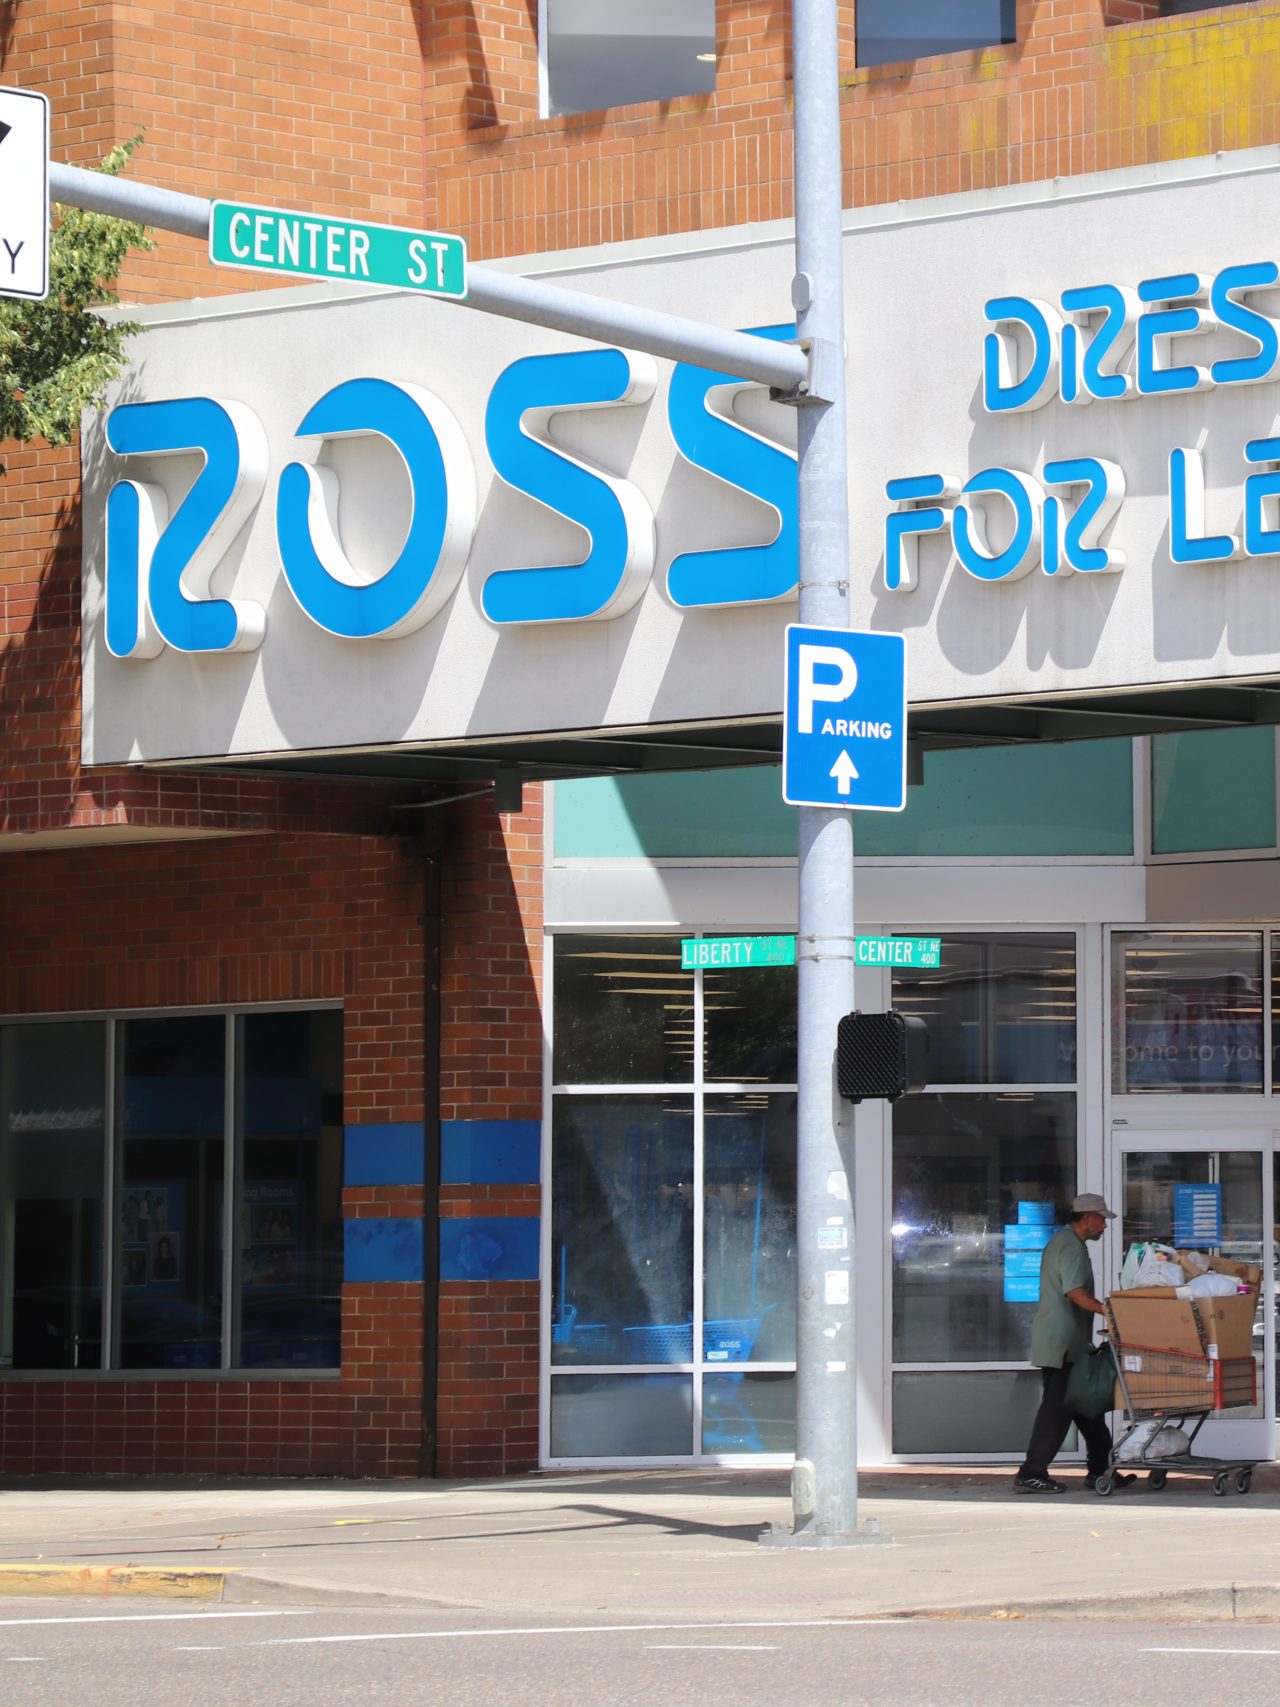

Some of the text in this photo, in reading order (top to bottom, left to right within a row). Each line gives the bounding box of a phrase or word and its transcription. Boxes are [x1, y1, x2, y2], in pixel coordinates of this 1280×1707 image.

[229, 212, 449, 287] CENTER ST
[106, 323, 800, 658] ROSS
[884, 456, 1126, 592] FOR
[683, 941, 753, 966] LIBERTY
[858, 940, 940, 963] CENTER ST NE
[920, 953, 936, 965] 400
[1187, 1043, 1213, 1062] to
